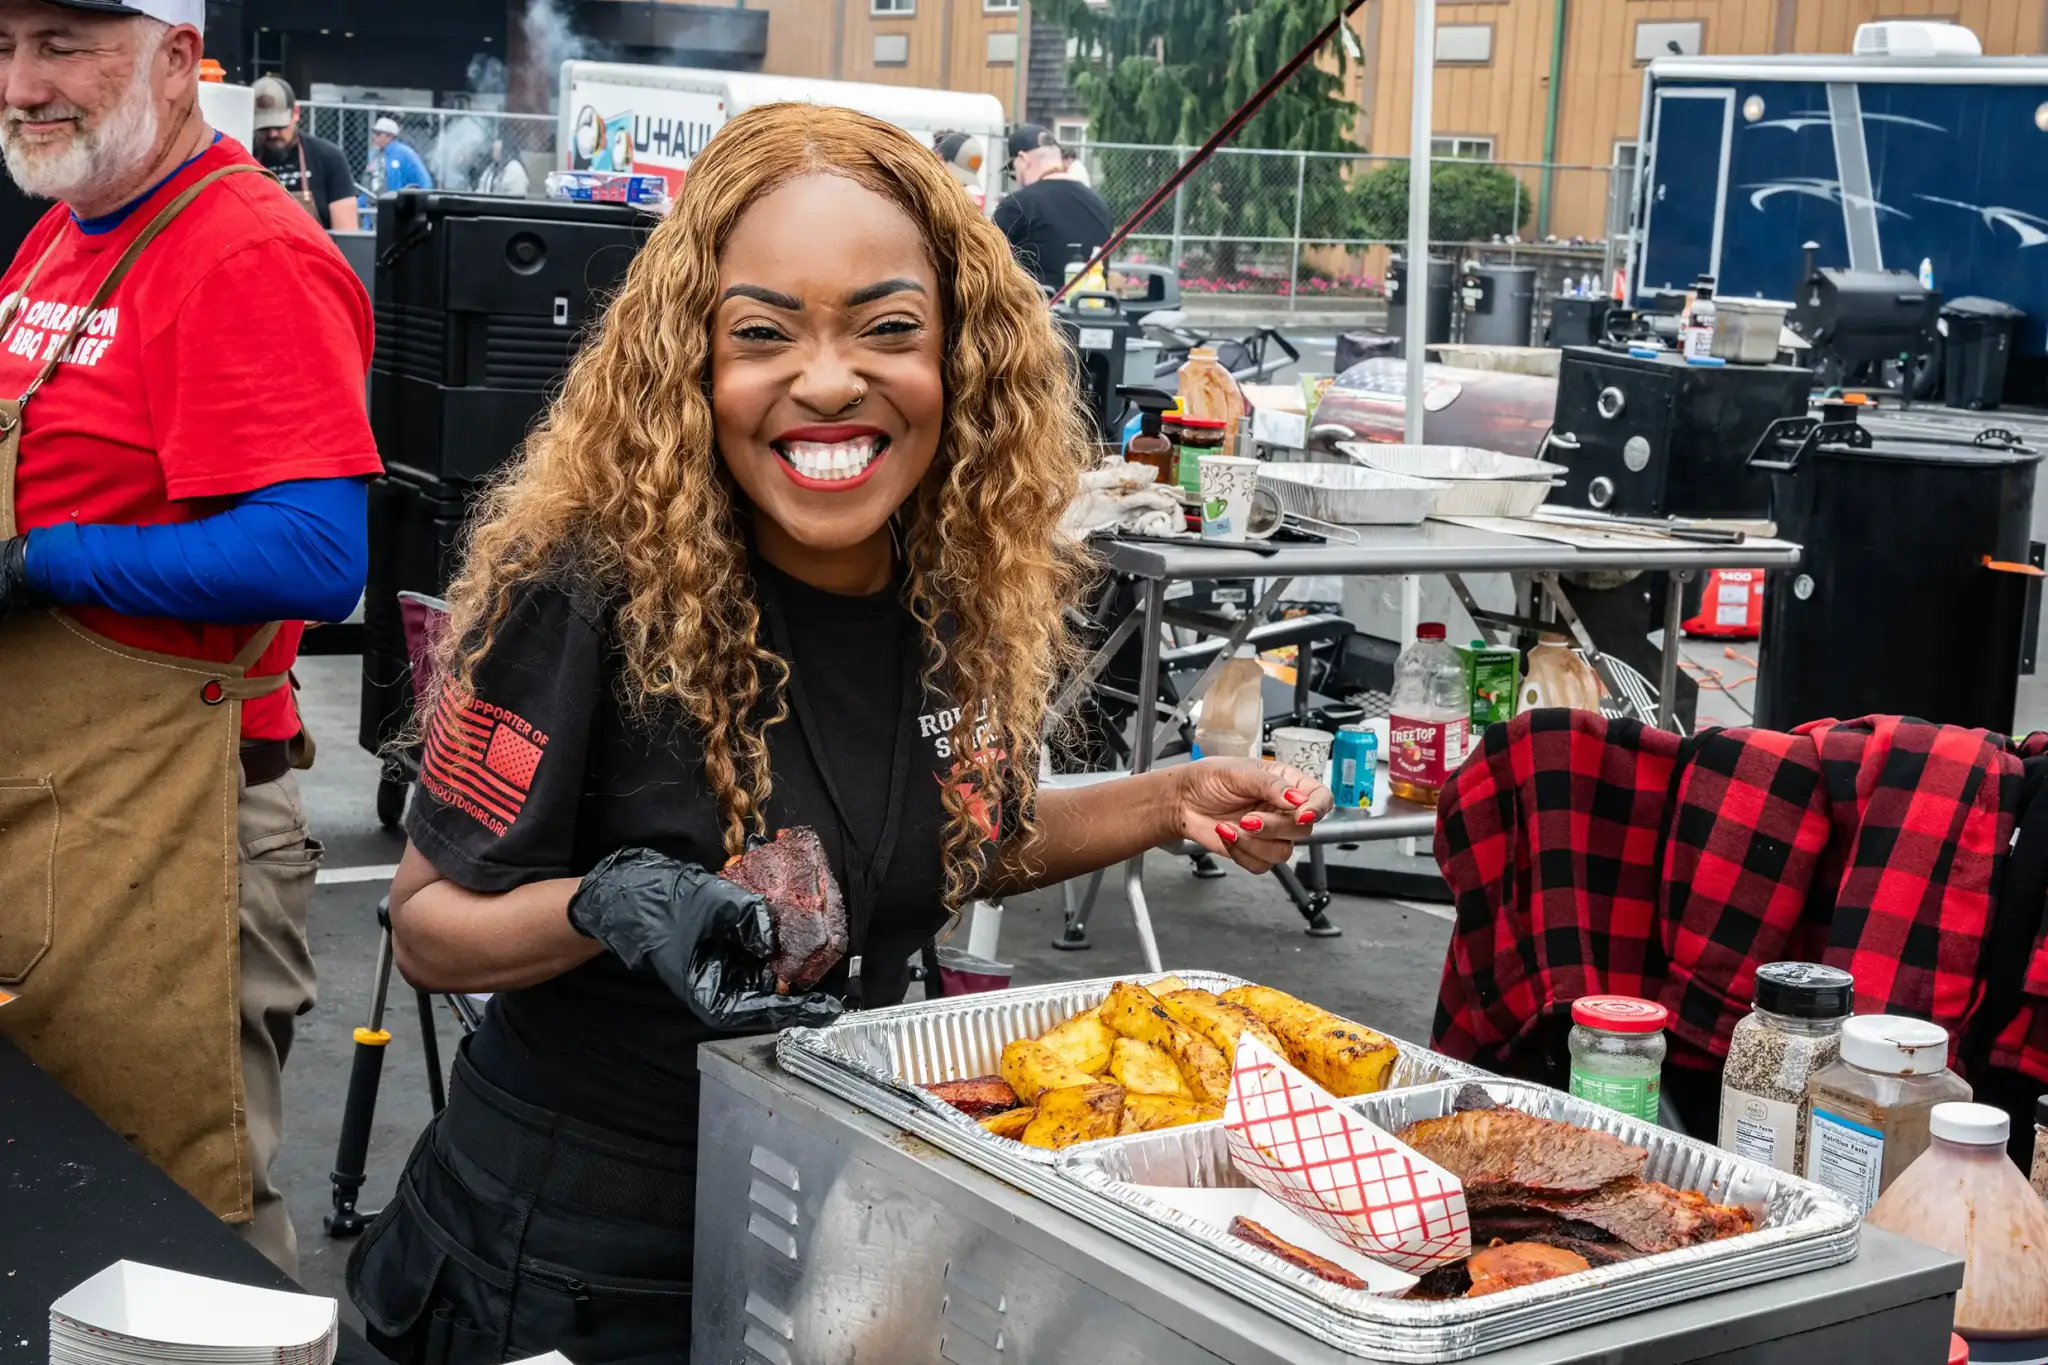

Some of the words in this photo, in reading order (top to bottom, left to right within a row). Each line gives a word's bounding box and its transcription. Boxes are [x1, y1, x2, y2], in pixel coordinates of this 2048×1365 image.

[7, 326, 44, 362] BBQ
[41, 333, 109, 367] RLIEF
[468, 697, 533, 738] PPORTER
[532, 729, 550, 746] OF
[1737, 1119, 1758, 1129] Nutrition
[1758, 1125, 1773, 1133] Facts
[1822, 1133, 1849, 1148] Nutrition
[1850, 1144, 1868, 1155] Facts
[1858, 1166, 1867, 1175] 10
